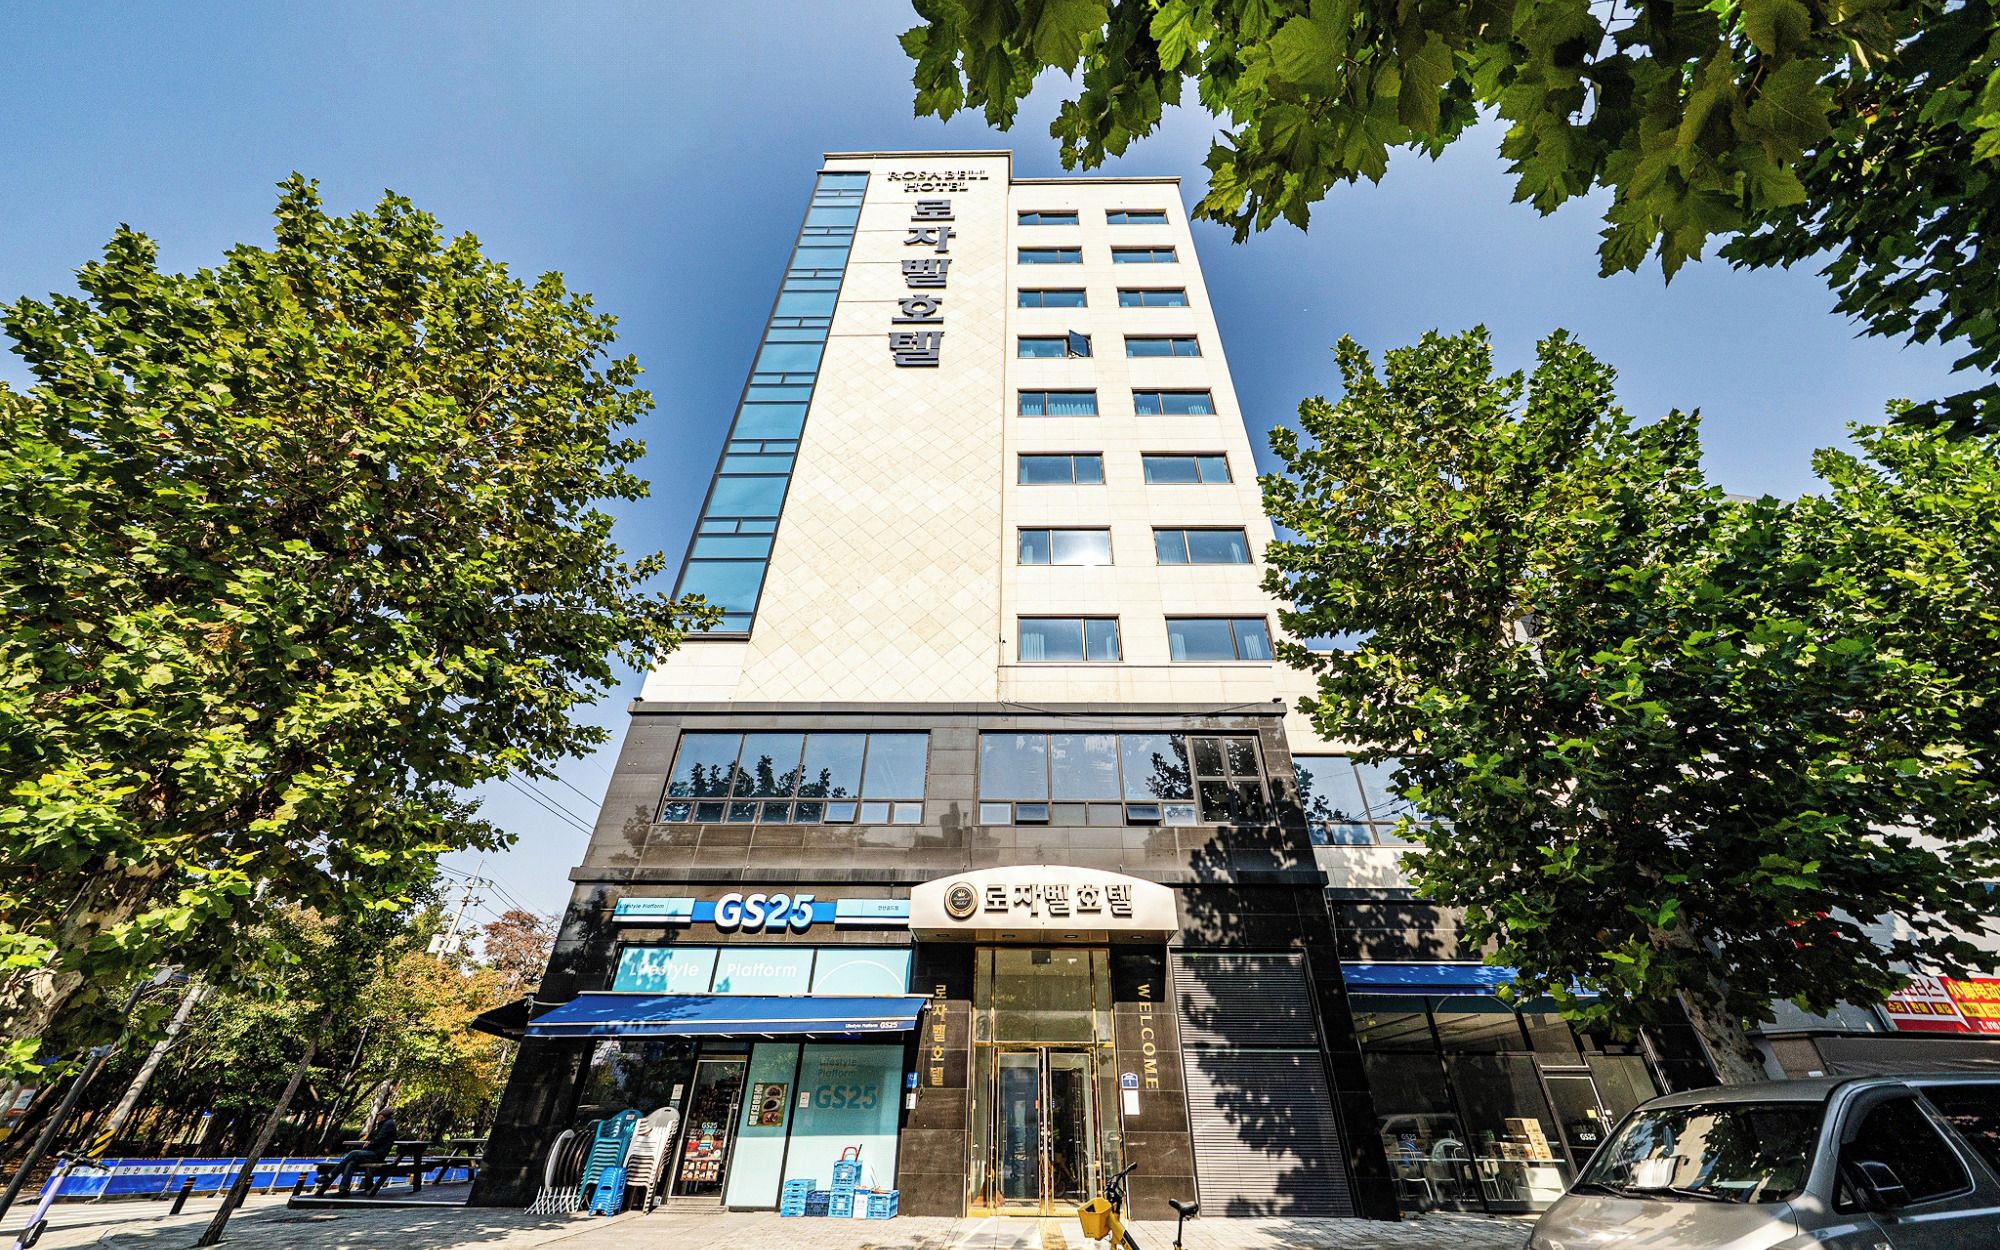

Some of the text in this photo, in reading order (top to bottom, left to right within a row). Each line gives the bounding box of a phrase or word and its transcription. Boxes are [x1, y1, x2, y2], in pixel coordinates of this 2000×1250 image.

[887, 170, 989, 181] ROSABELL
[904, 182, 968, 192] HOTEL
[983, 884, 1133, 917] 로자벨호텔
[714, 892, 815, 931] GS25
[726, 962, 797, 977] Platform
[1137, 984, 1160, 1090] WELCOME
[815, 1084, 878, 1110] GS25
[701, 1121, 718, 1129] GS25
[1580, 1132, 1597, 1141] GS25
